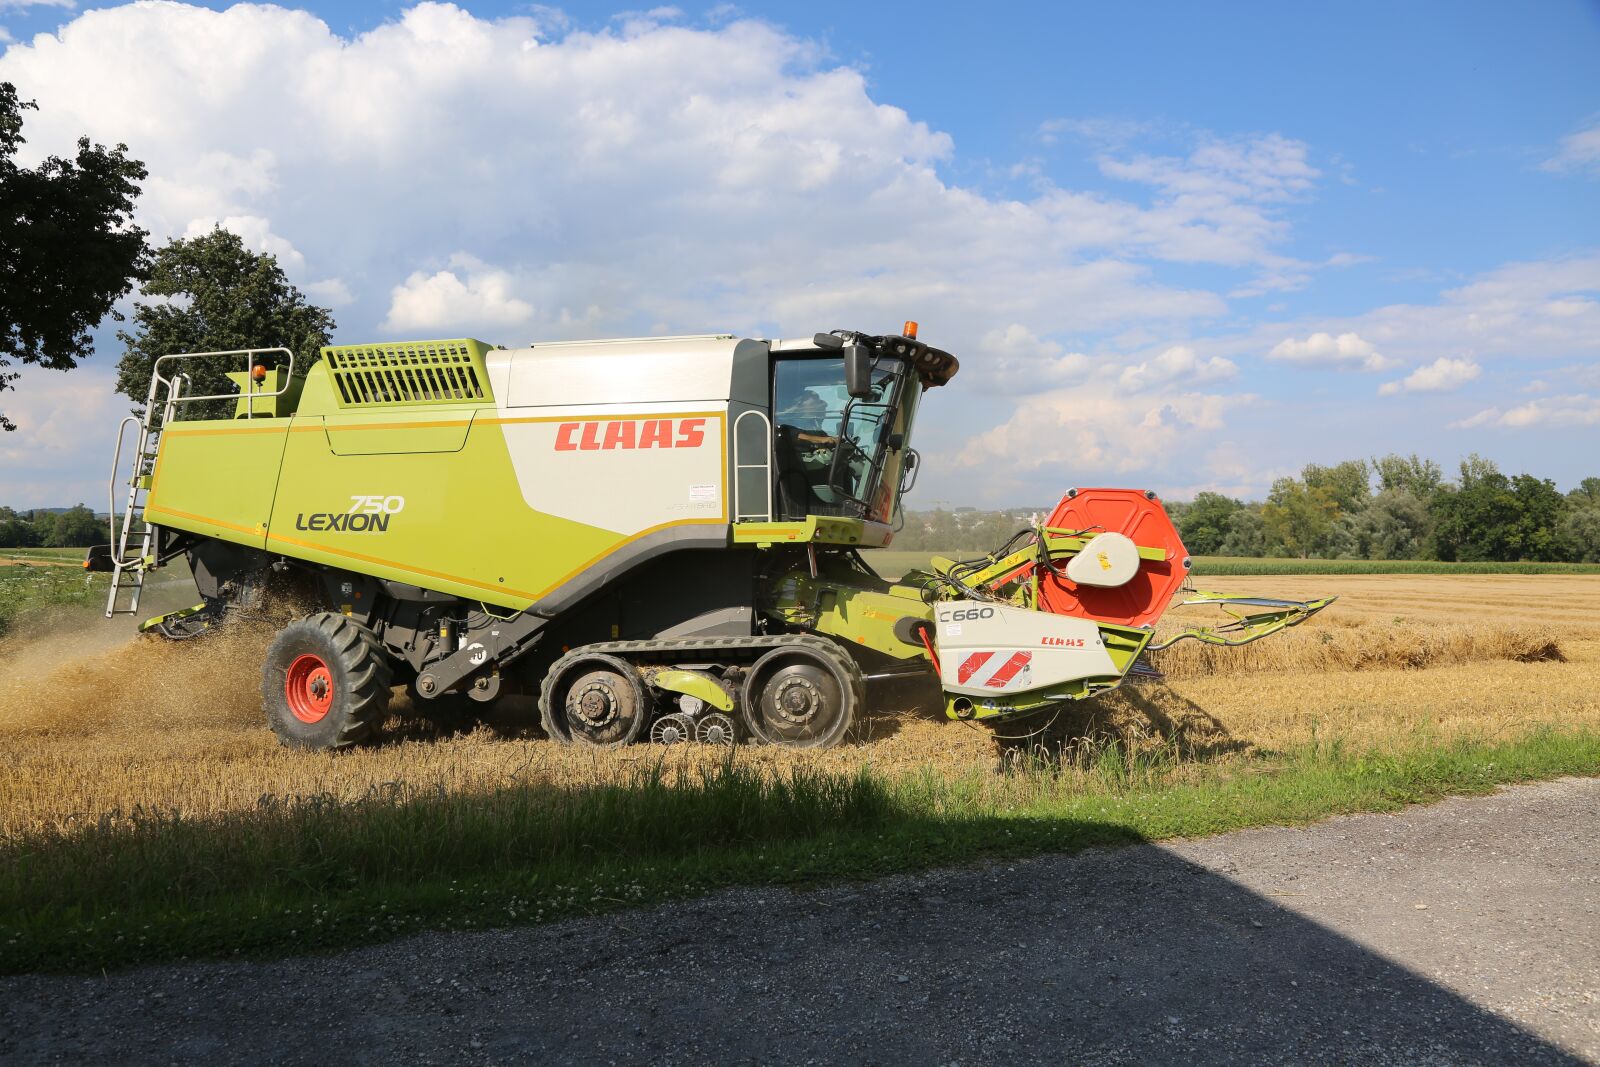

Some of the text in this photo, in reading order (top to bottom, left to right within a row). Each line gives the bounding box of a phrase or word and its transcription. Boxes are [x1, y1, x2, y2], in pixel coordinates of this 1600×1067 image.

[554, 419, 706, 451] CLAAS
[347, 495, 405, 514] 750
[295, 513, 390, 532] LEXION
